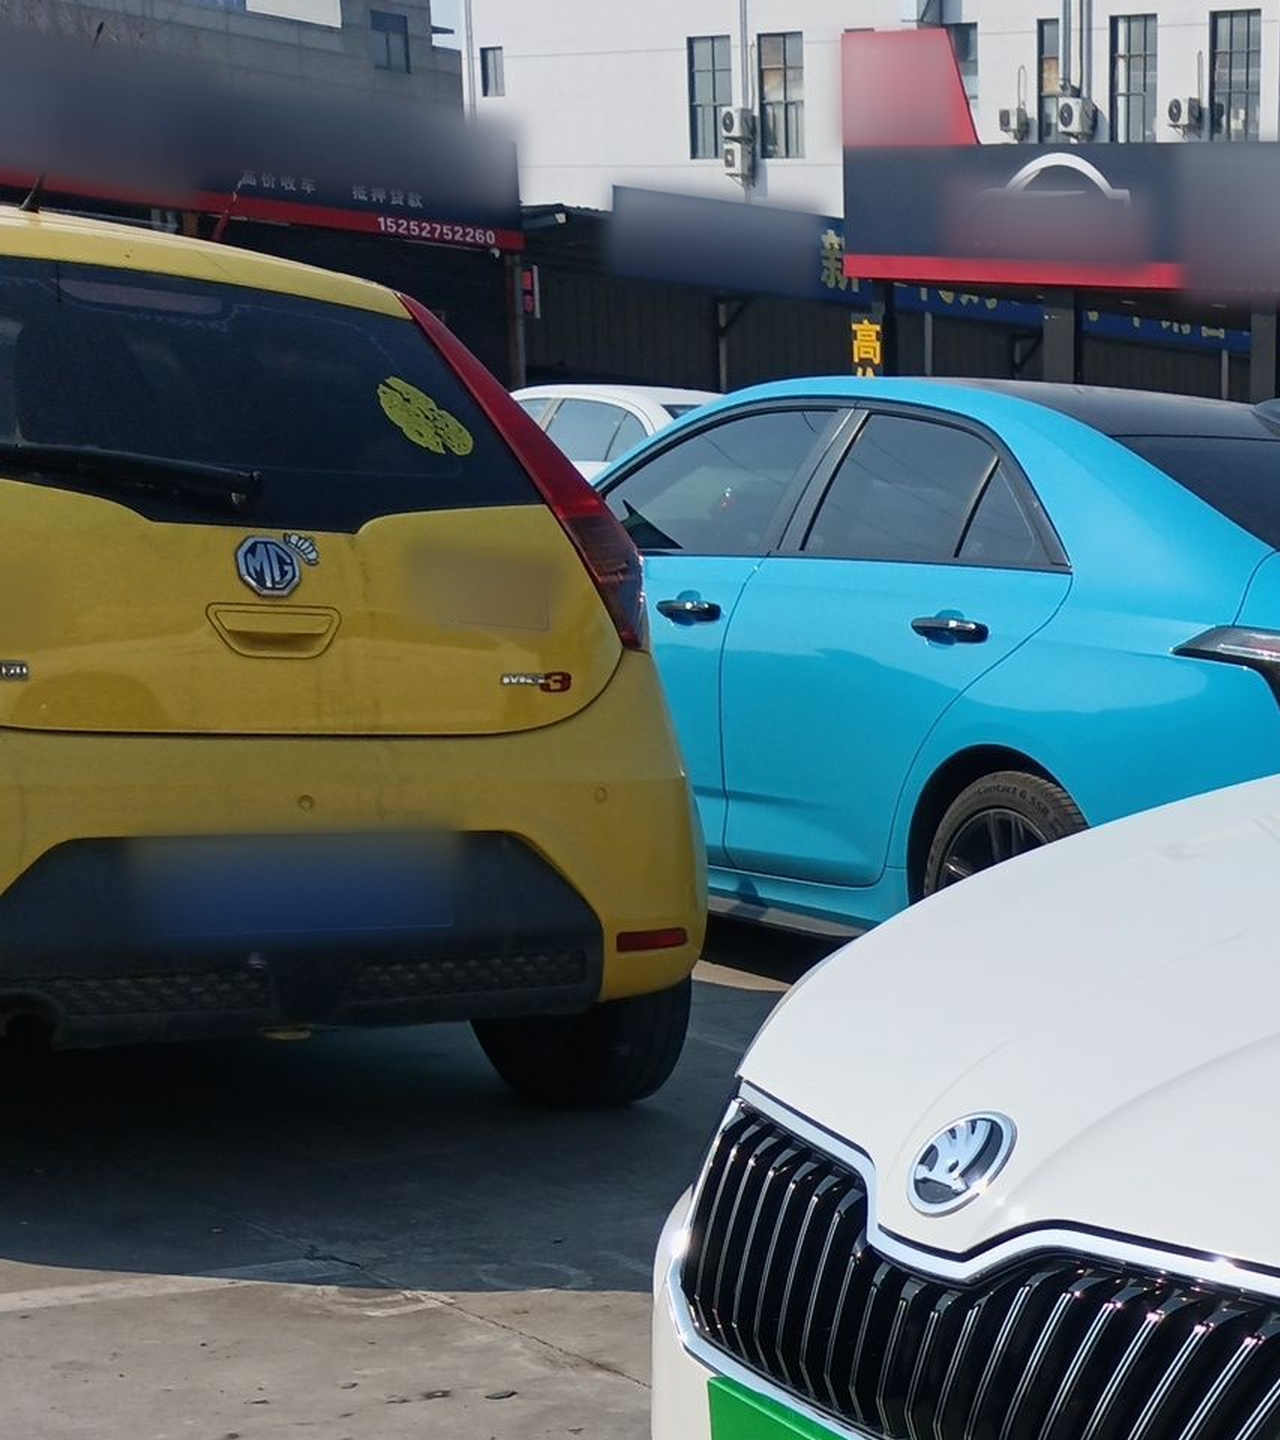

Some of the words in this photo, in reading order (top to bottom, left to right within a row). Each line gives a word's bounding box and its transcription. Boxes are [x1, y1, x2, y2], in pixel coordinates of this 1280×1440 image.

[240, 170, 317, 194] 高价收车
[376, 216, 497, 245] 15252752260
[851, 319, 881, 377] 高
[245, 541, 295, 589] MG
